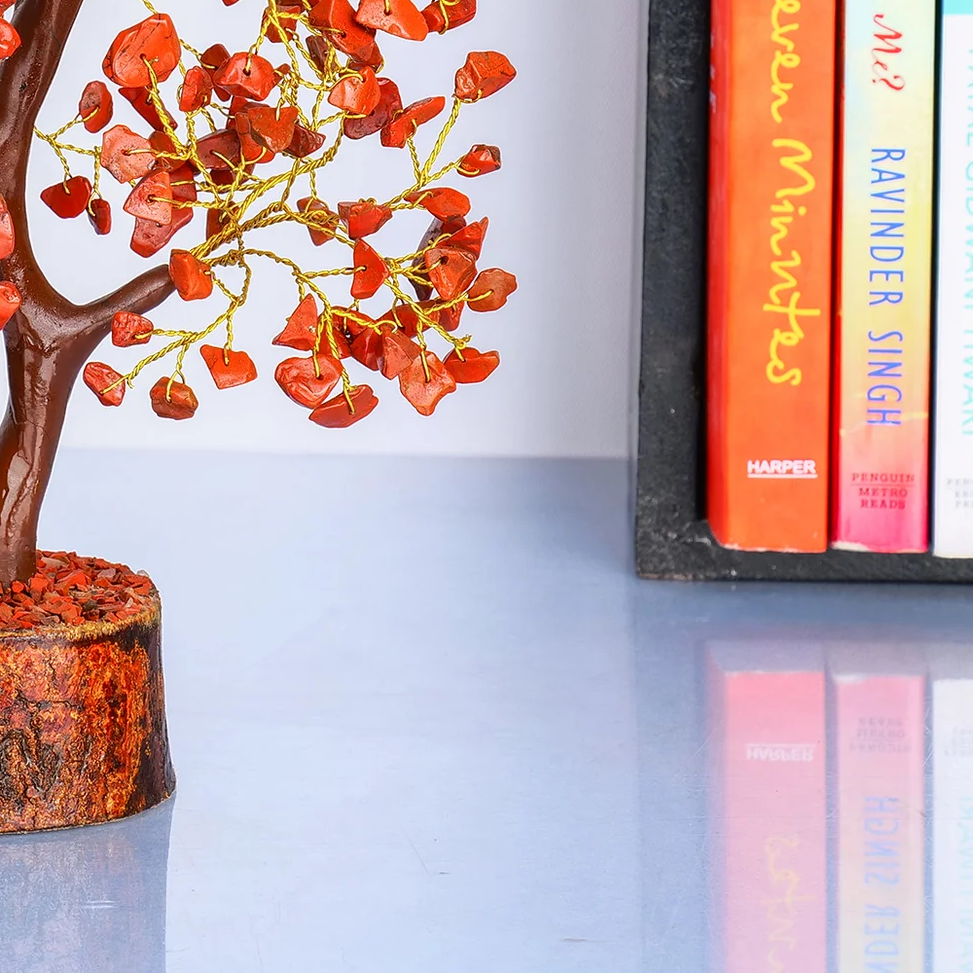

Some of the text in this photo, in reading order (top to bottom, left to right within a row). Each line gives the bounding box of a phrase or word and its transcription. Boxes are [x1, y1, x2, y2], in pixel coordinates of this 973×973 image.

[872, 14, 905, 92] Me?
[762, 138, 821, 387] Minutes
[866, 147, 907, 427] RAVINDER SINGH
[747, 459, 817, 475] HARPER
[851, 472, 915, 483] PENGUIN
[858, 487, 909, 498] METRO
[860, 499, 906, 510] READS
